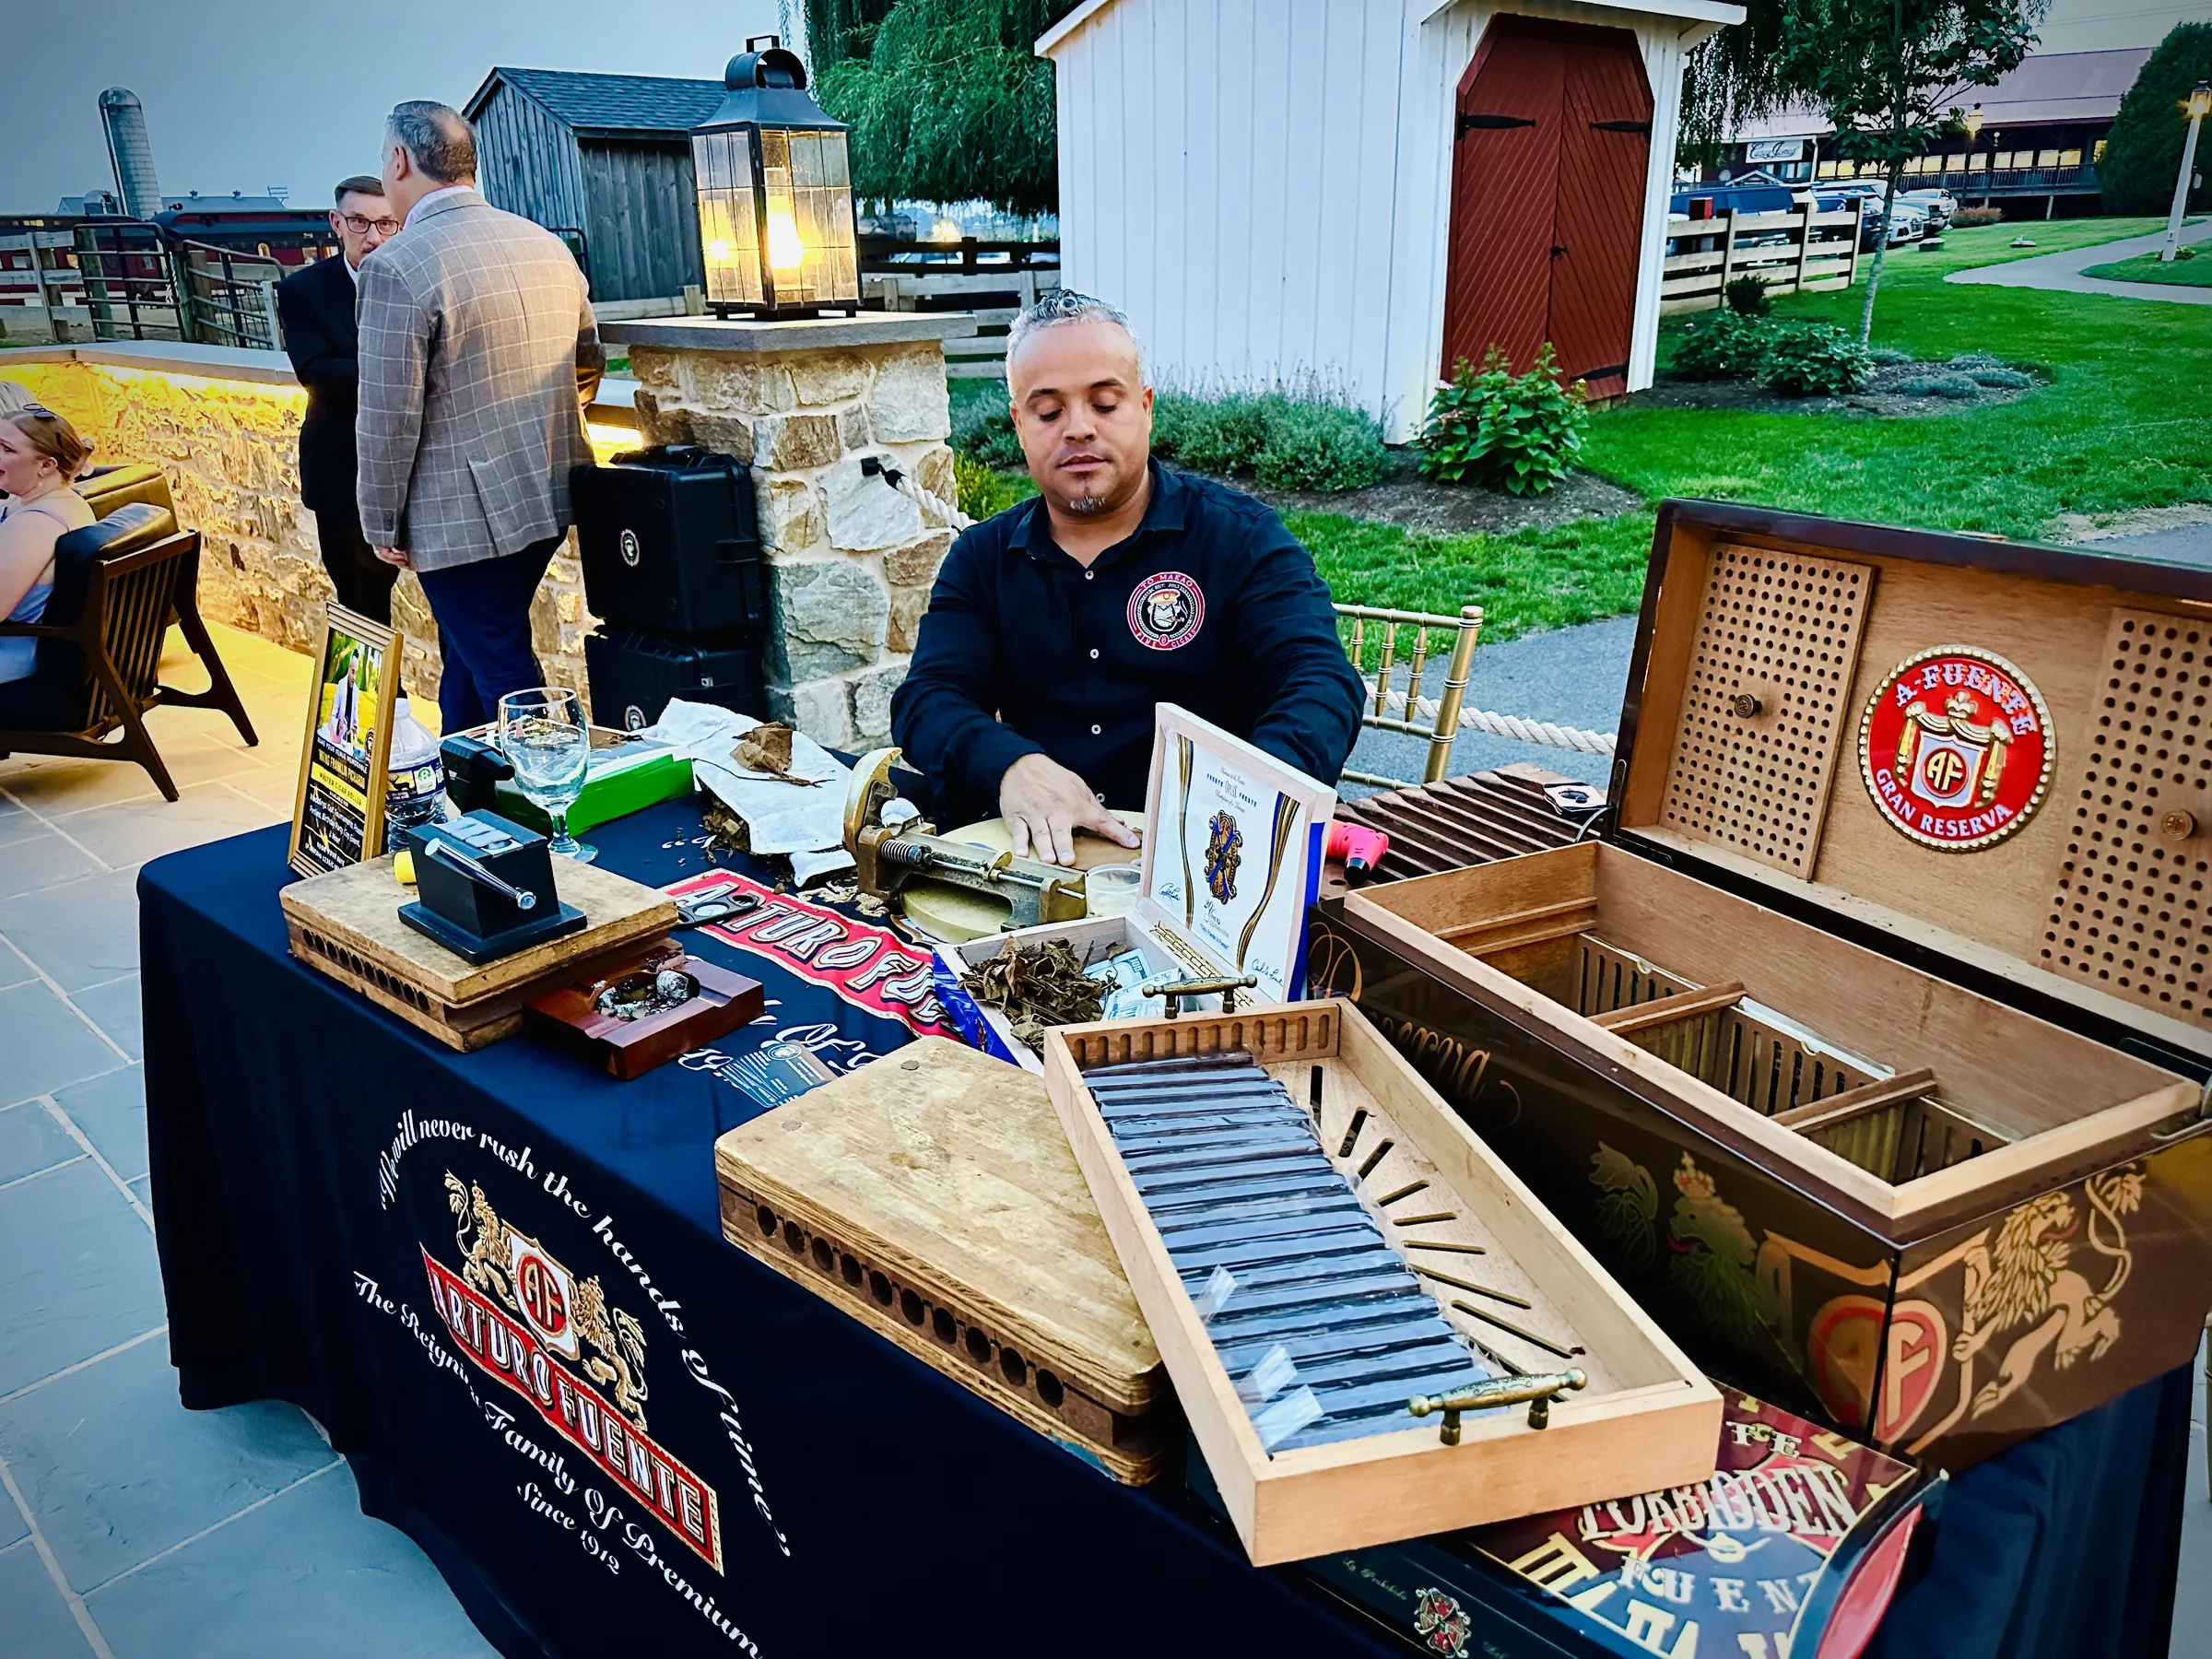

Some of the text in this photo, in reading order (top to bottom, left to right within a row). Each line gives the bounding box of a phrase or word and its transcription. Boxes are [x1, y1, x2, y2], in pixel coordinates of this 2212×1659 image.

[1141, 573, 1193, 589] TO MAKAO
[1171, 629, 1196, 648] CIGARS
[335, 782, 347, 794] CIGAR
[347, 790, 362, 806] ROLLER
[1876, 768, 2015, 838] GRAN RESERVA
[1926, 750, 1964, 791] AF
[676, 881, 882, 969] ATURO
[392, 1109, 418, 1164] will
[419, 1119, 476, 1140] never
[479, 1133, 538, 1180] rush
[543, 1171, 591, 1218] the
[592, 1216, 687, 1339] hands
[524, 1262, 564, 1328] AF
[432, 1268, 553, 1405] ARTURO
[353, 1270, 397, 1315] The
[485, 1401, 580, 1495] Family
[584, 1488, 624, 1530] Of
[622, 1523, 764, 1659] Premium
[556, 1372, 704, 1545] FUENTE
[1725, 1420, 1802, 1458] TE
[517, 1482, 620, 1575] Since 1912
[1582, 1466, 1858, 1542] FORBIDDEN
